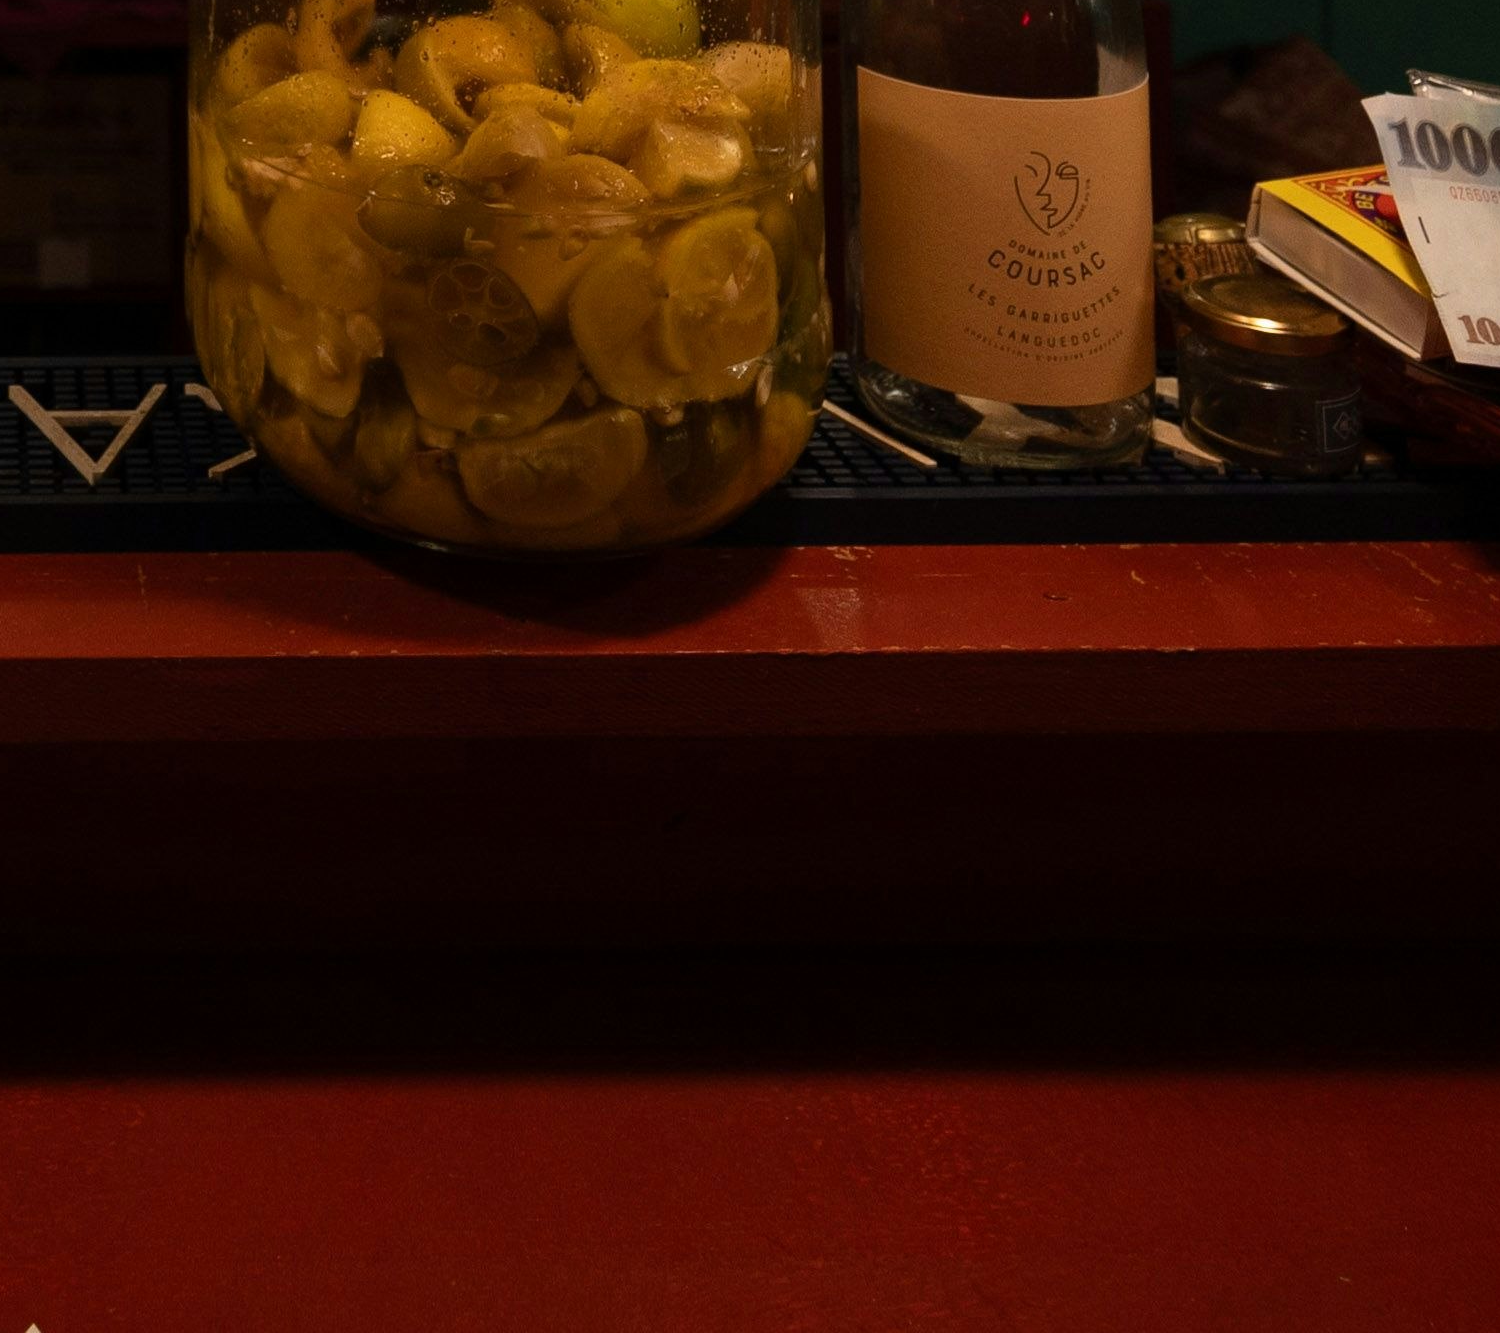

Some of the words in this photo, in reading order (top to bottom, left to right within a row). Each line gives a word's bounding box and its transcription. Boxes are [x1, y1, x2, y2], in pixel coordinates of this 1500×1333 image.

[1008, 239, 1067, 260] DOMAINE
[1072, 239, 1089, 255] DE
[987, 249, 1106, 288] COURSAC
[967, 283, 997, 307] LES
[1006, 285, 1121, 324] GARRIGUETTES
[997, 326, 1101, 349] LANGUEDOC
